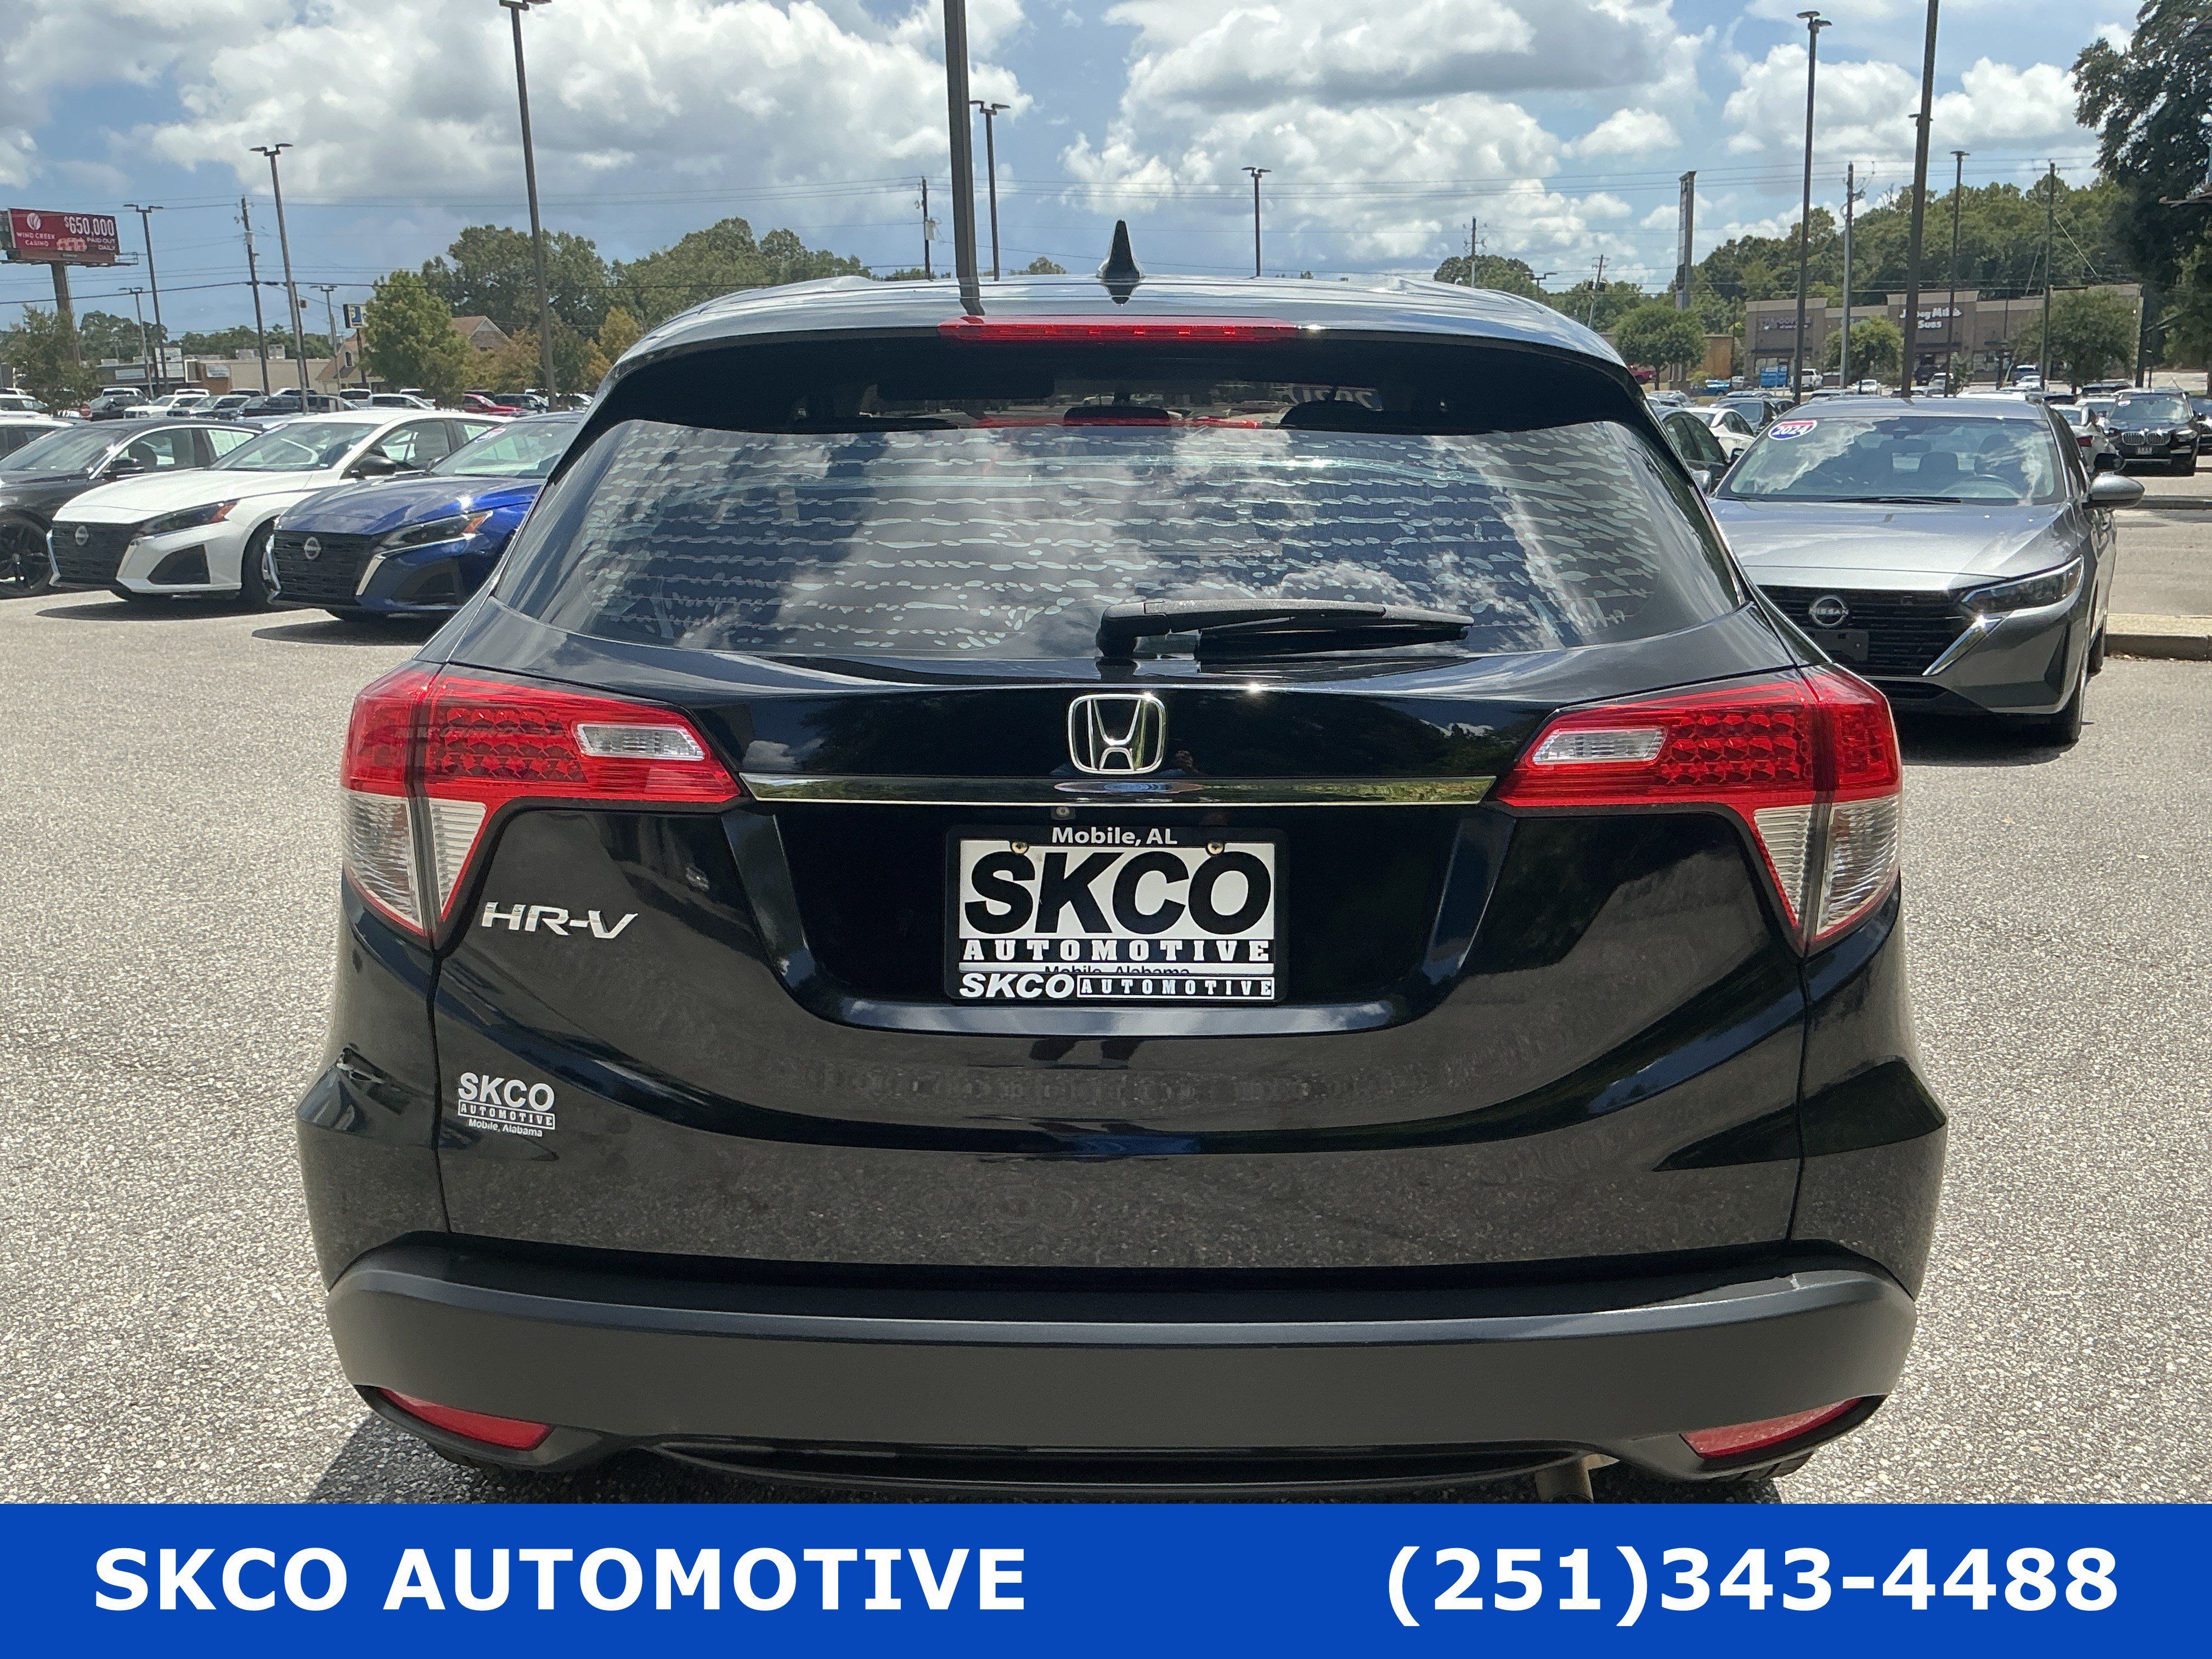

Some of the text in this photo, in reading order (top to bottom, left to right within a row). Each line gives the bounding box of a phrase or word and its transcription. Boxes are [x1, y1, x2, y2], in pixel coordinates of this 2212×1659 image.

[64, 216, 115, 236] $650,000
[1771, 425, 1810, 435] 2024
[1052, 826, 1178, 847] Mobile, AL
[964, 851, 1272, 935] SKCO
[481, 901, 639, 939] HR-V
[963, 940, 1269, 961] AUTOMOTIVE
[959, 973, 1272, 998] SKCO AUTOMOTIVE
[458, 1072, 555, 1111] SKCO
[460, 1103, 553, 1126] AUTOMOTIVE
[469, 1118, 543, 1138] Mobile, Alabama
